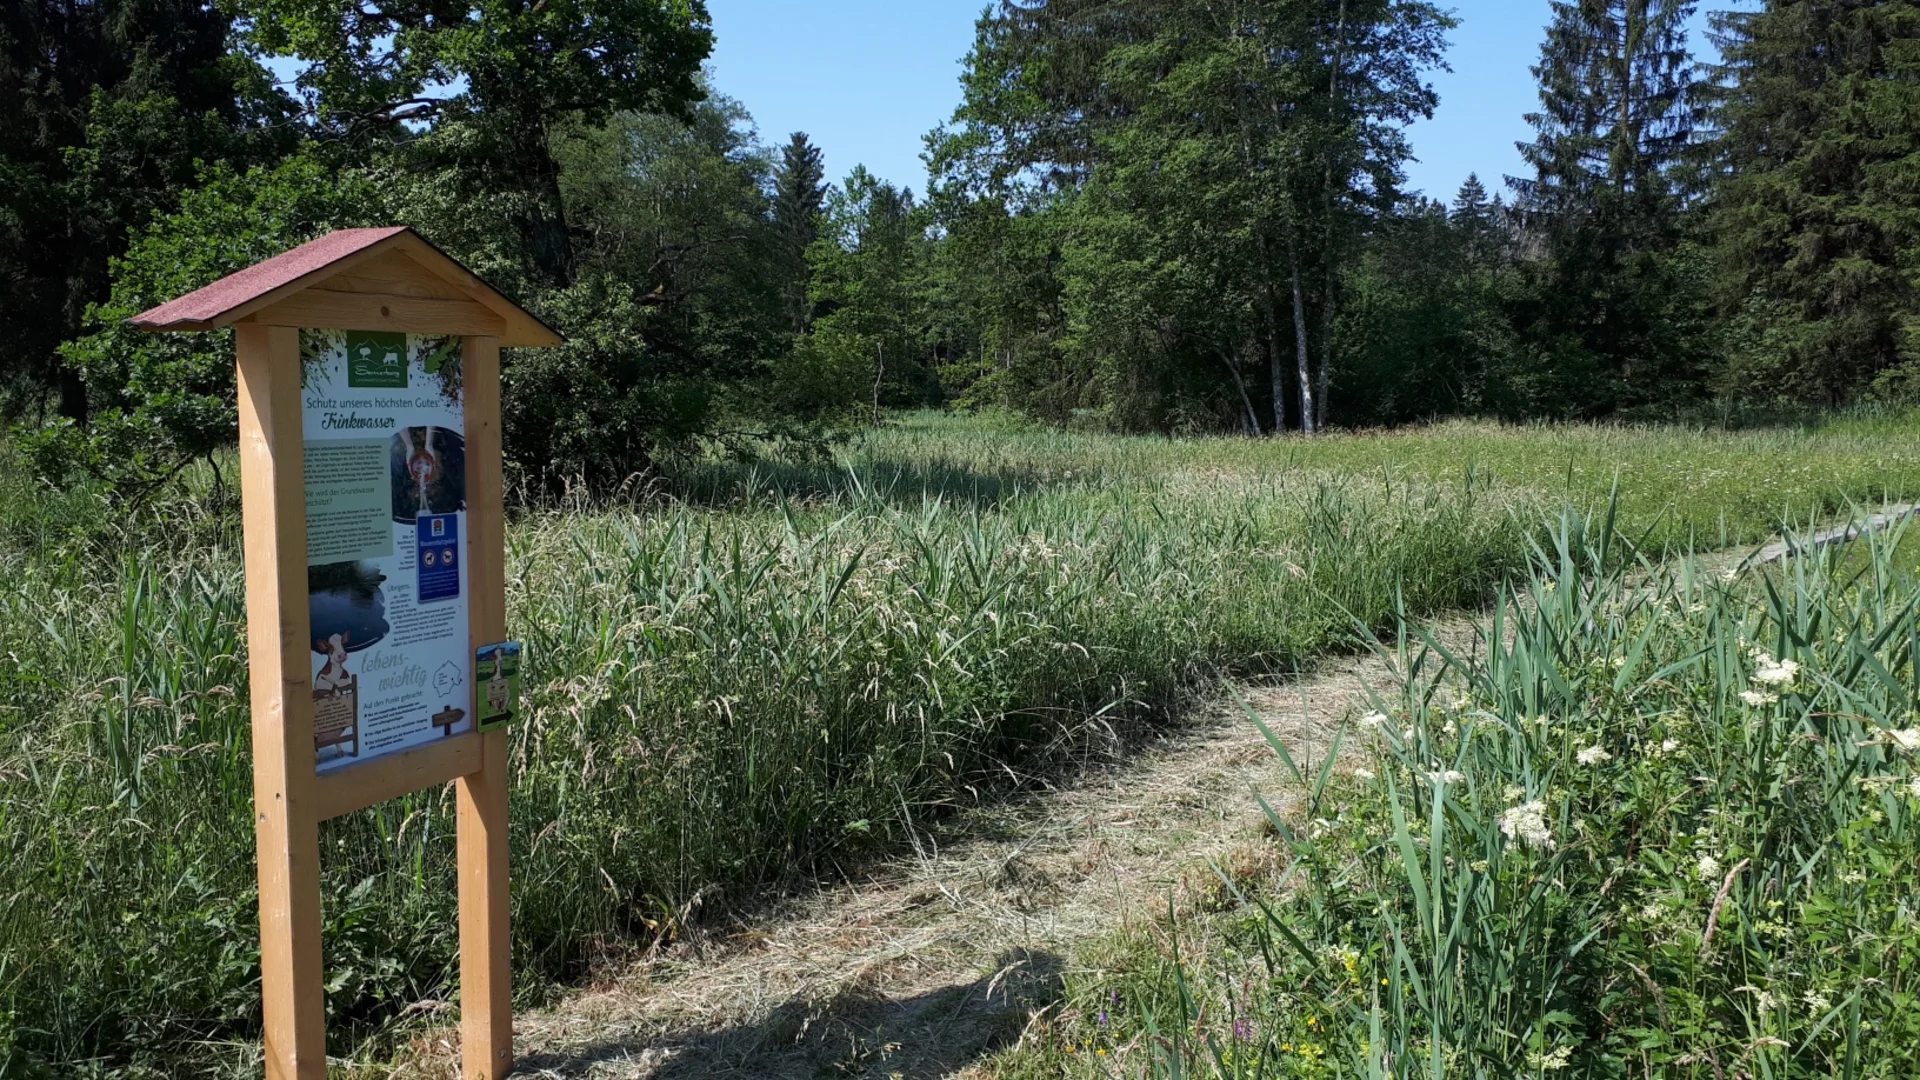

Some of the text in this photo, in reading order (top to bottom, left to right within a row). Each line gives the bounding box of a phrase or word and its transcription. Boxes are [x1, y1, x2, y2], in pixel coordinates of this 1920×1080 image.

[306, 397, 337, 409] Schutz
[339, 399, 373, 409] unseres
[374, 397, 413, 409] höchsten
[321, 411, 396, 430] Trinkwasser
[360, 649, 409, 674] lebens-
[378, 664, 427, 692] wichtig
